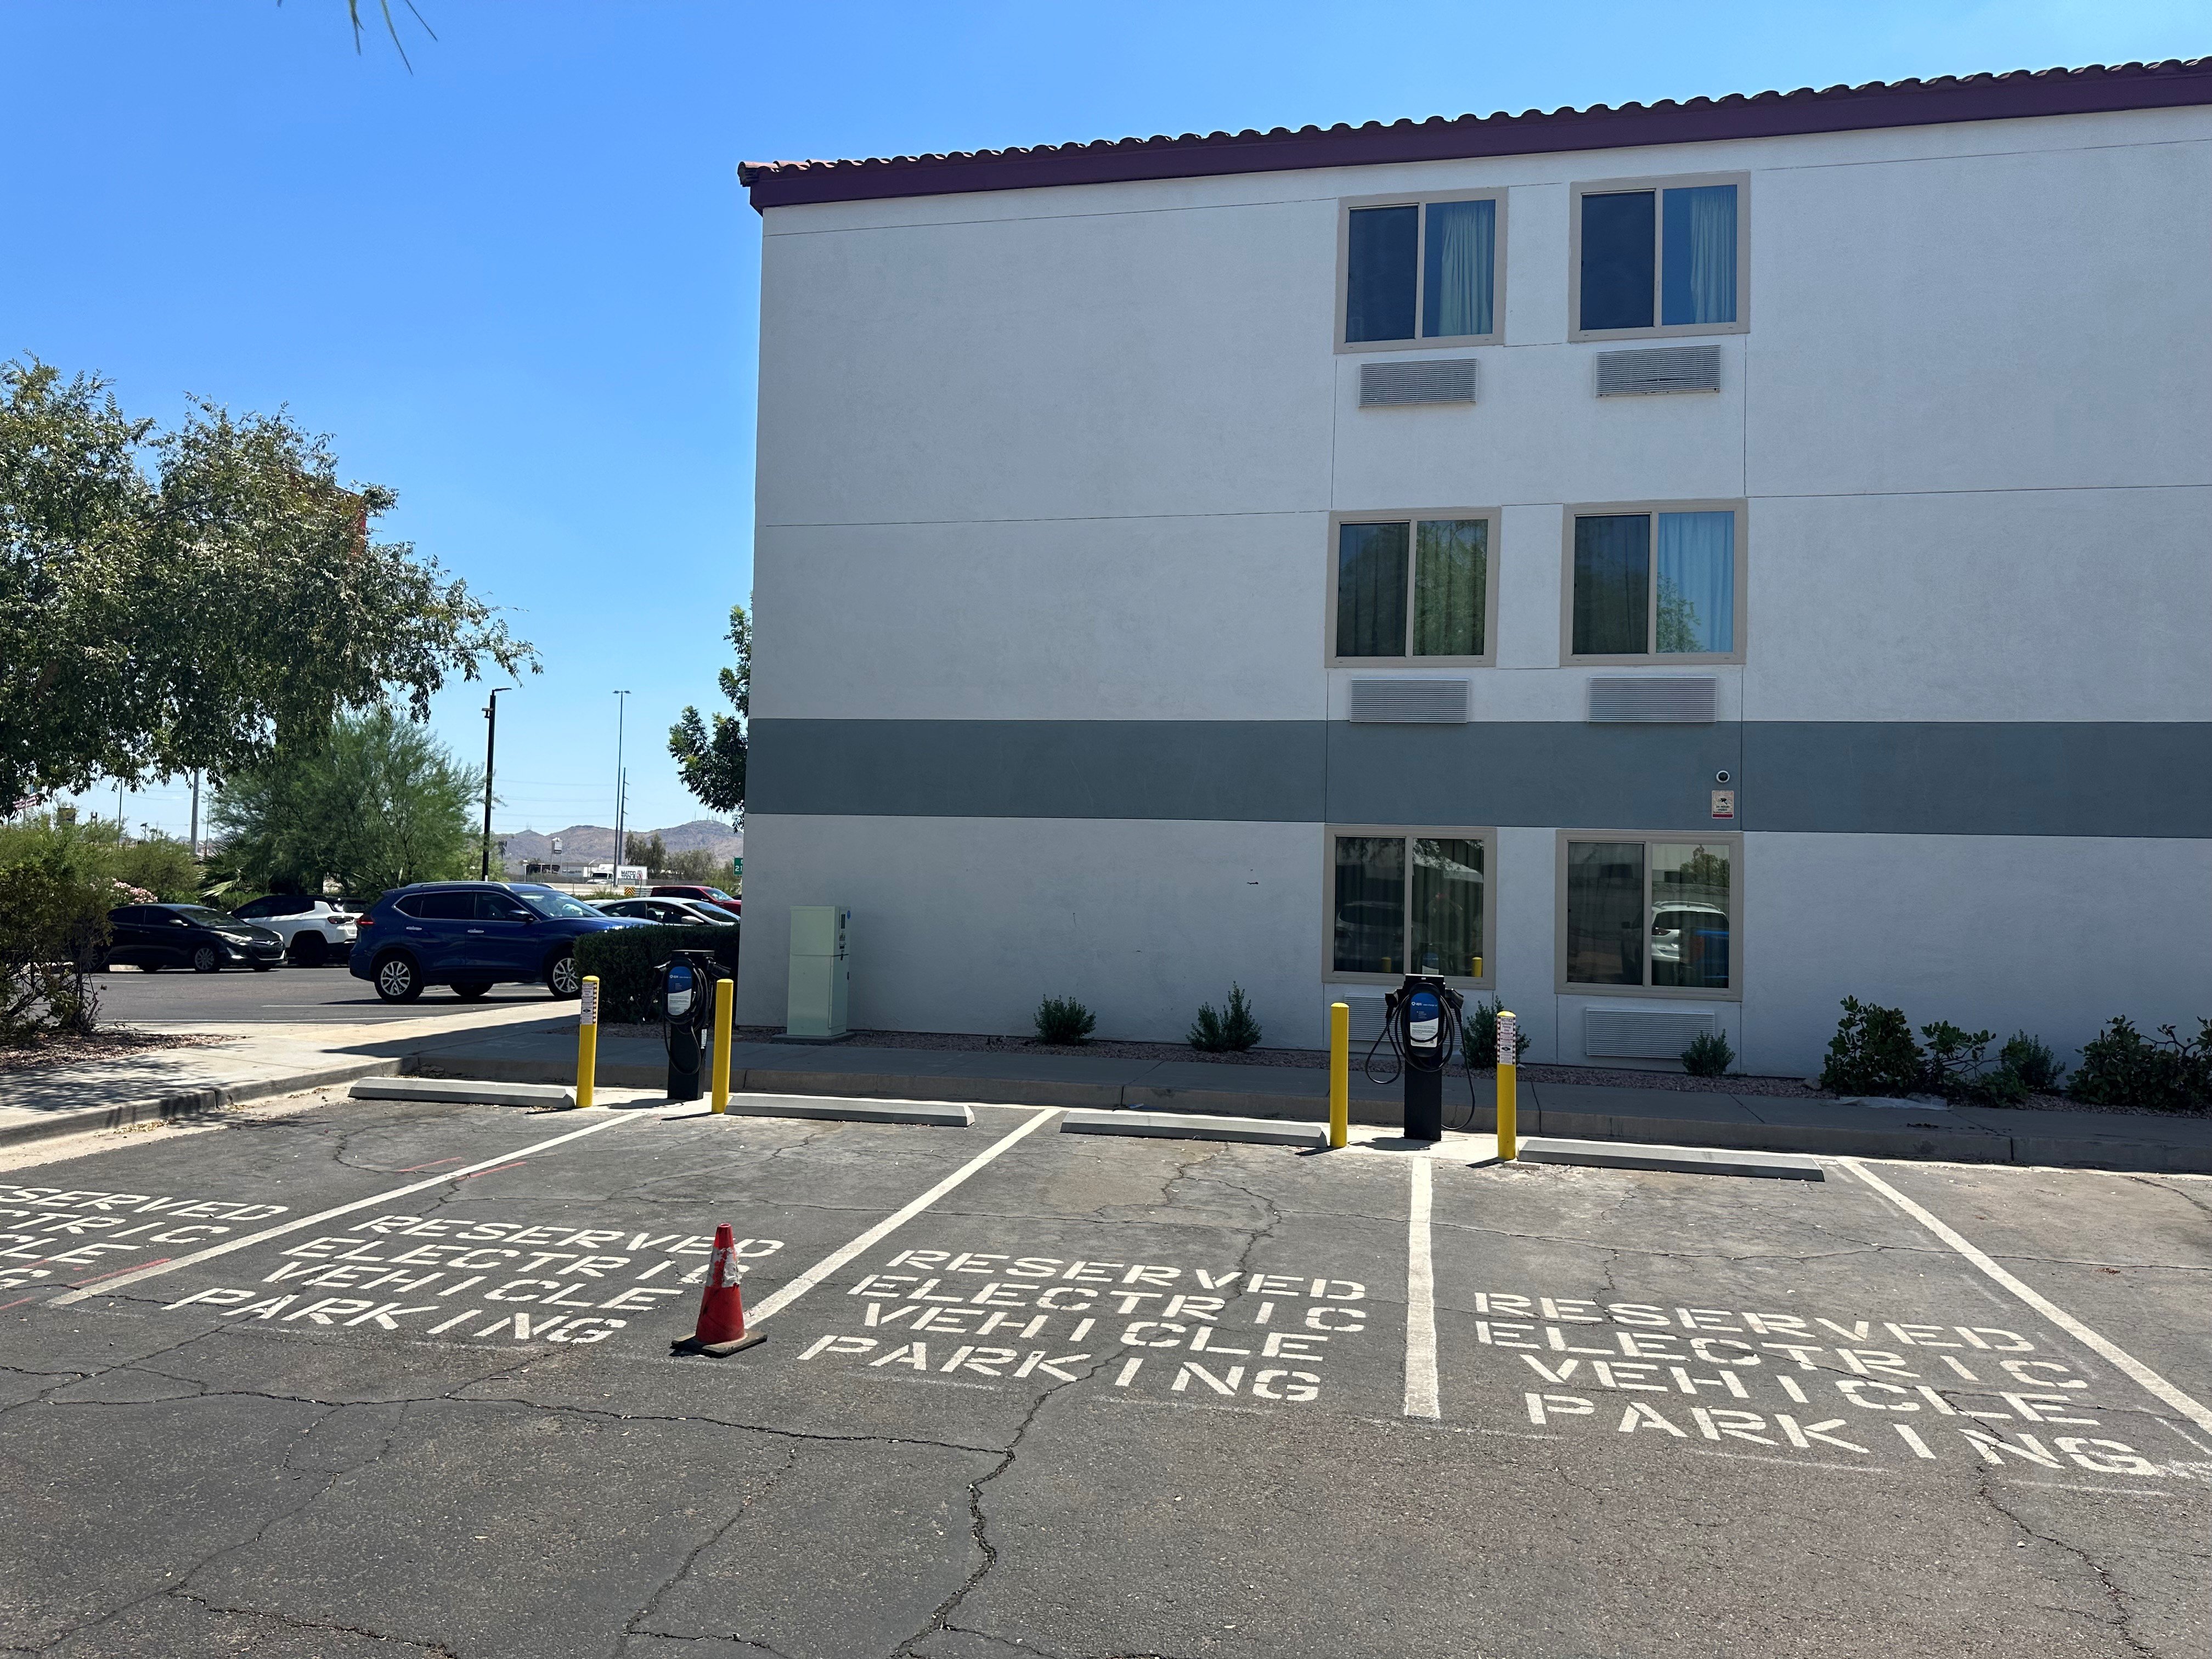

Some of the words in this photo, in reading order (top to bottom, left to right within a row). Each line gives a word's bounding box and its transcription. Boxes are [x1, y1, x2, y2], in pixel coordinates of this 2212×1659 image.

[348, 1216, 785, 1257] RESERVED
[263, 1260, 685, 1311] VEHICLE
[847, 1274, 1365, 1332] ELECTRIC
[887, 1250, 1365, 1301] RESERVED
[161, 1288, 627, 1345] PARKING
[864, 1301, 1332, 1362] VEHICLE
[1475, 1292, 2035, 1352] RESERVED
[797, 1335, 1321, 1402] PARKING
[1475, 1321, 2087, 1390] ELECTRIC
[1520, 1353, 2102, 1425] VEHICLE
[1524, 1392, 2160, 1476] PARKING
